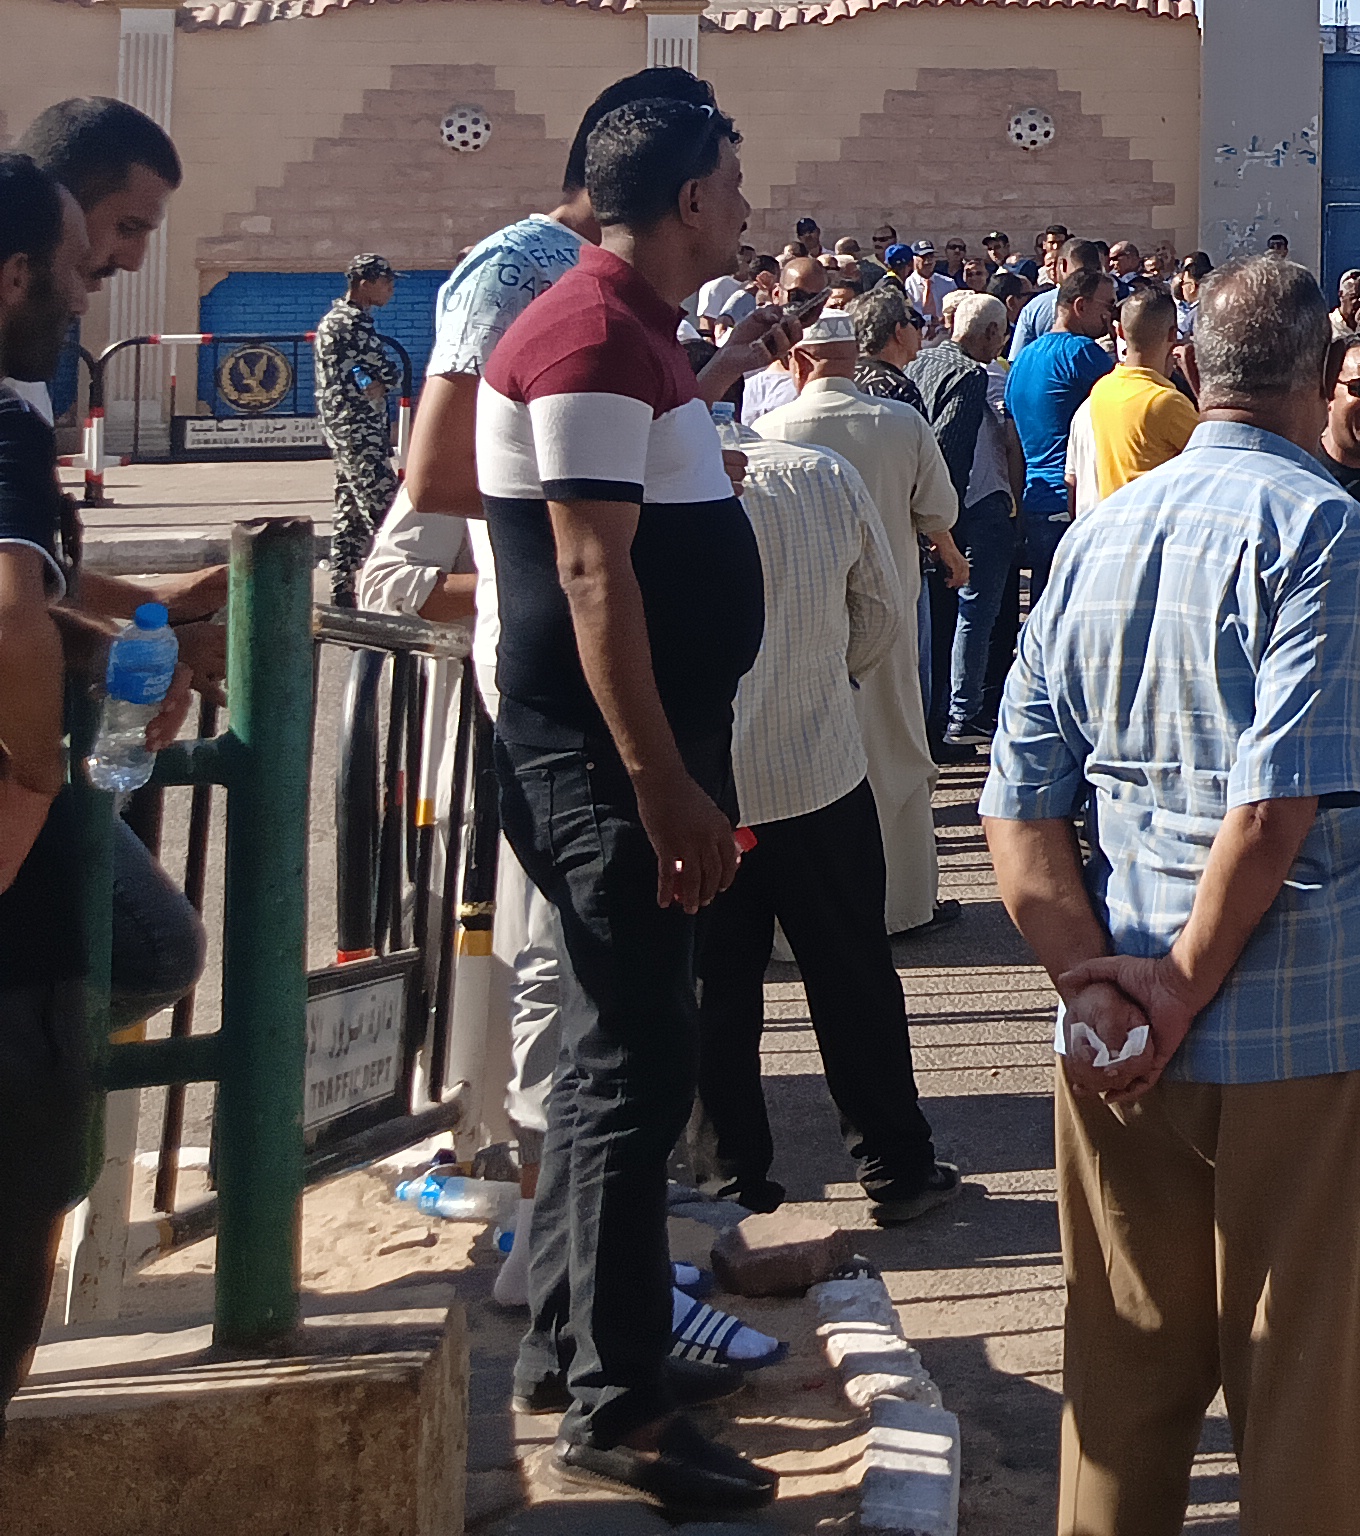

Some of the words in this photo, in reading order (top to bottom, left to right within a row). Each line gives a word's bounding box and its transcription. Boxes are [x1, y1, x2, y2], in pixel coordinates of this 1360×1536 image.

[243, 436, 287, 445] TRAFFIC
[291, 435, 318, 444] DEPT
[310, 1066, 361, 1109] TRAFFIC
[362, 1056, 393, 1091] DEPT
